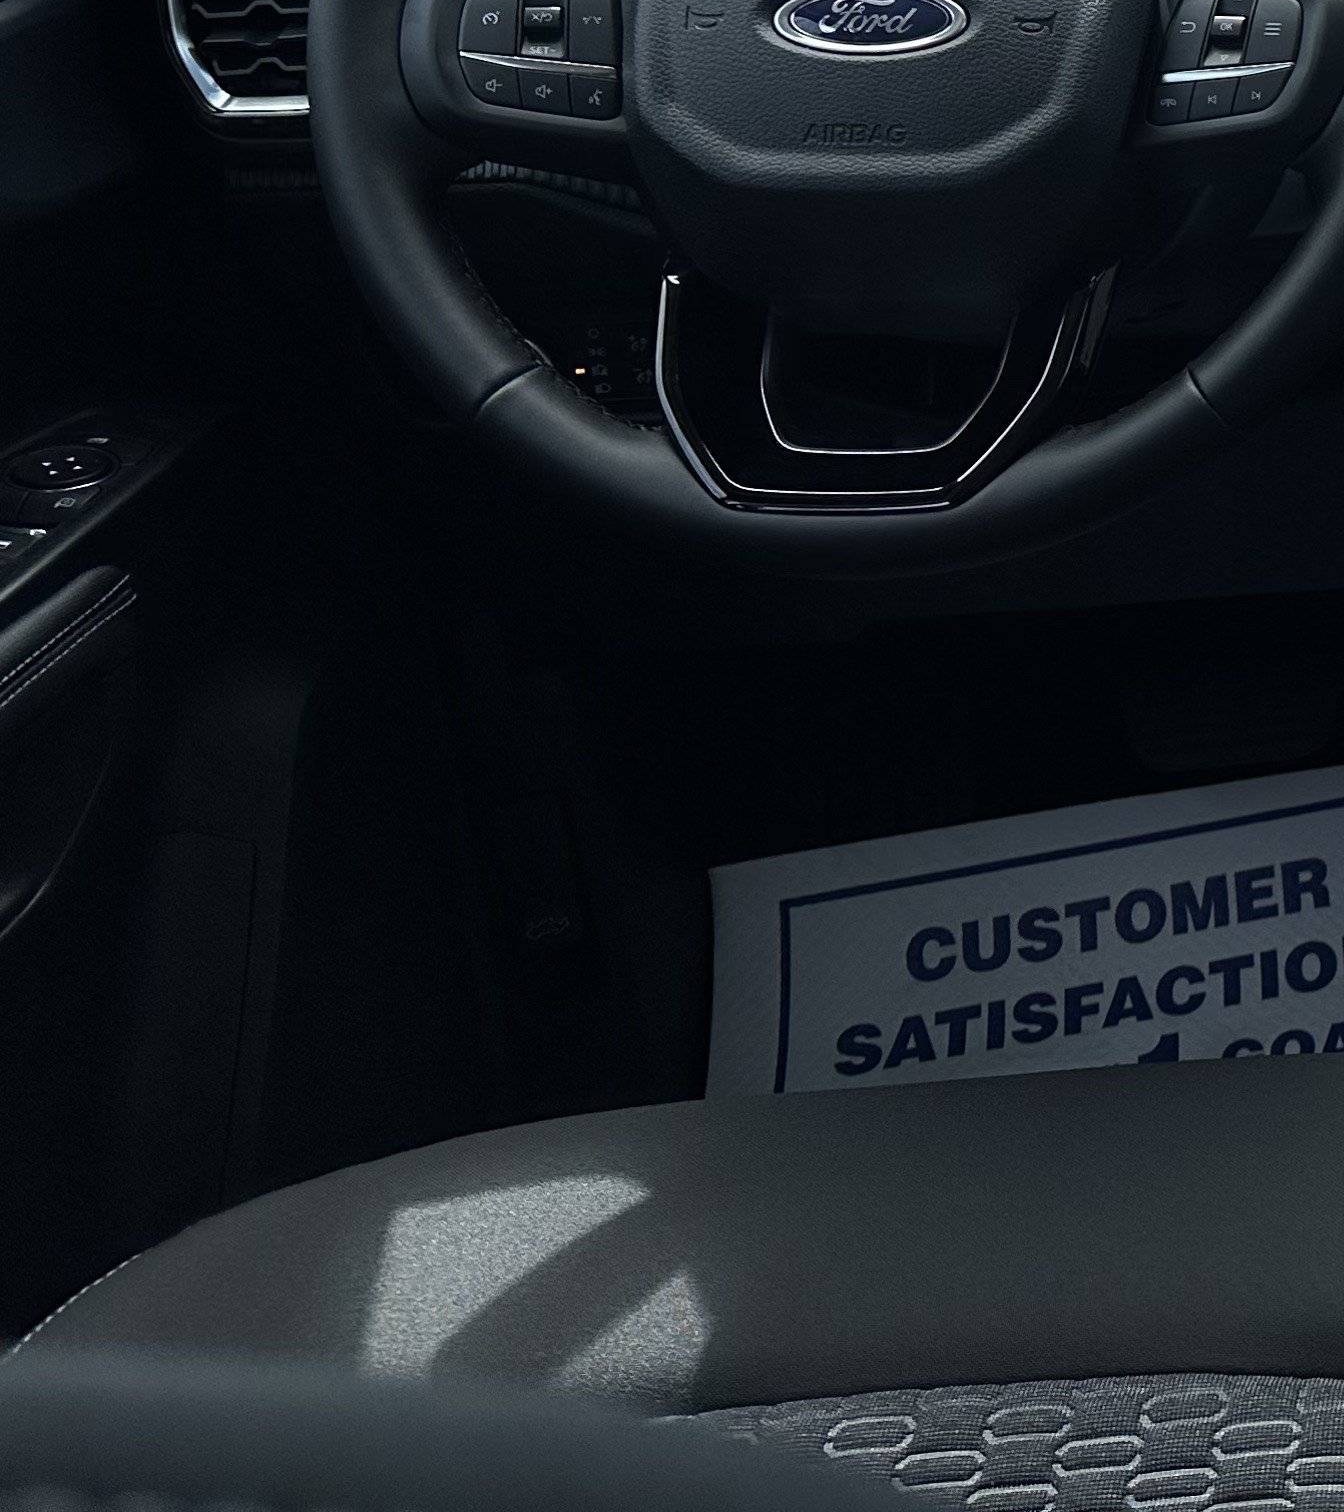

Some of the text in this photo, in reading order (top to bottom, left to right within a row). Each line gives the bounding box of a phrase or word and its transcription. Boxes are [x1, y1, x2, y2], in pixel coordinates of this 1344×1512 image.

[1219, 21, 1234, 32] OK
[803, 122, 908, 144] AIRBAG
[904, 856, 1331, 983] CUSTOMER
